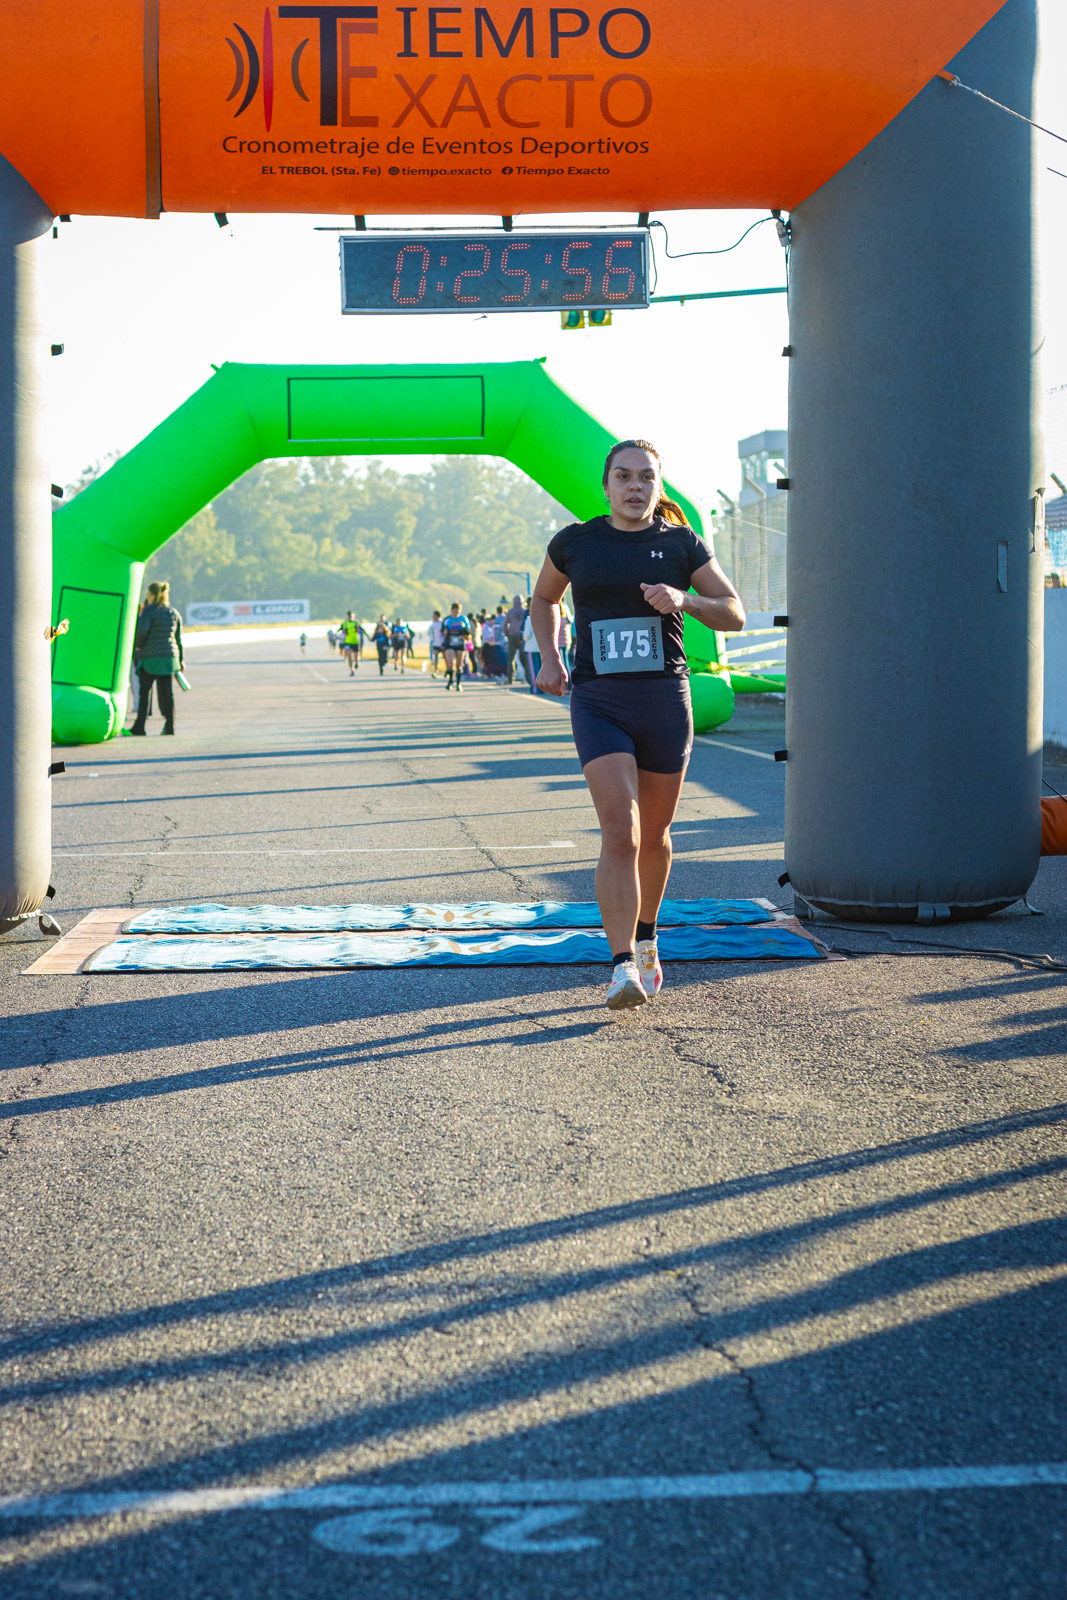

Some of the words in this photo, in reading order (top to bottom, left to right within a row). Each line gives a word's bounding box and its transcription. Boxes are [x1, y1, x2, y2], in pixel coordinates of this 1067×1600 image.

[222, 136, 380, 158] Cronometraje
[386, 136, 415, 155] de
[422, 137, 513, 155] Eventos
[520, 137, 650, 159] Deportivos
[261, 165, 277, 176] EL
[278, 165, 329, 176] TREBOL
[331, 165, 360, 177] (Sta.
[362, 165, 382, 177] Fe)
[402, 166, 493, 177] tiempo.exacto
[515, 166, 565, 177] Tiempo
[567, 166, 610, 176] Exacto
[392, 240, 636, 304] 0:25:56
[607, 630, 650, 659] 175
